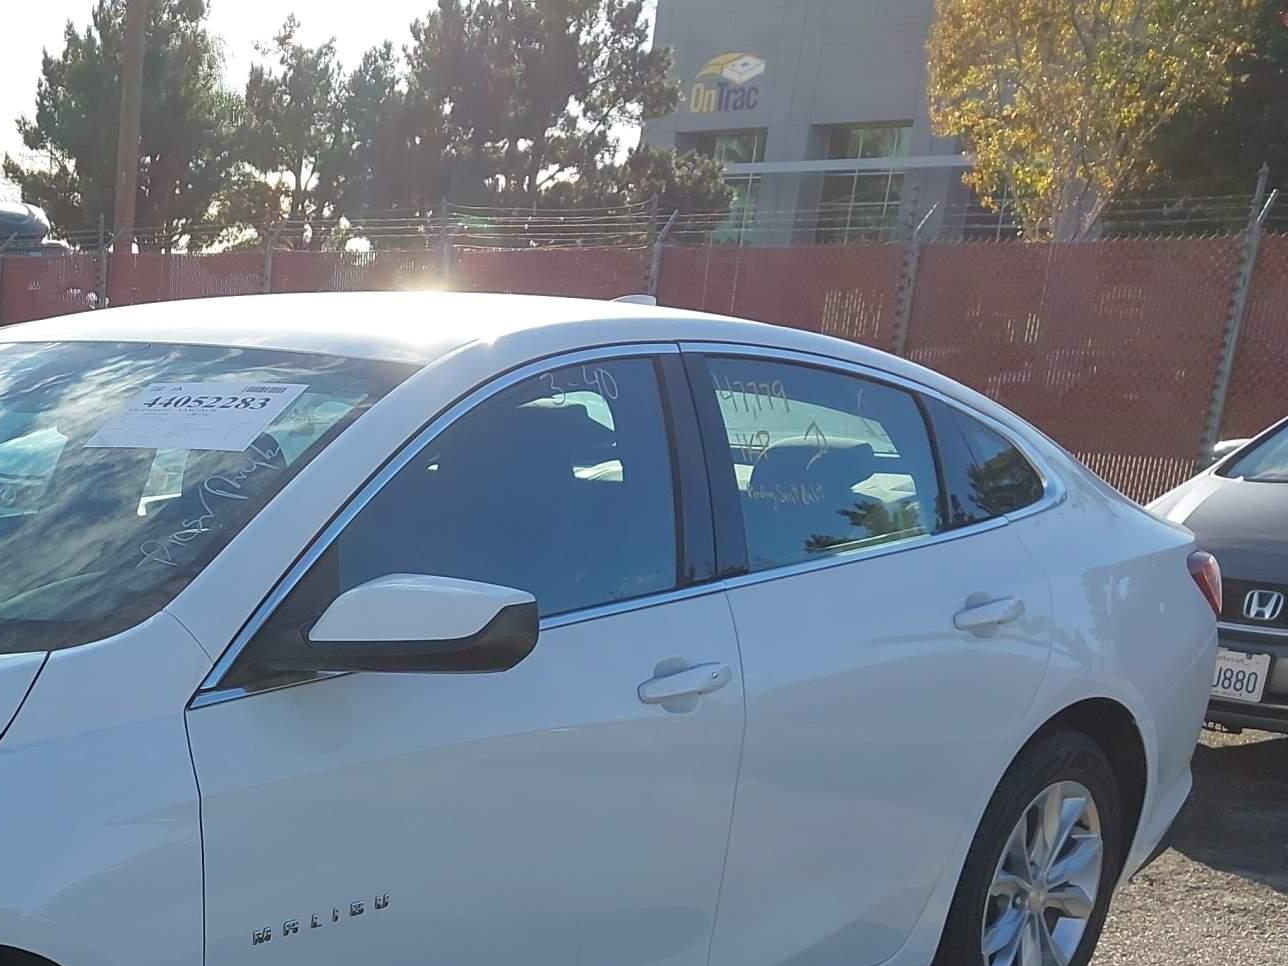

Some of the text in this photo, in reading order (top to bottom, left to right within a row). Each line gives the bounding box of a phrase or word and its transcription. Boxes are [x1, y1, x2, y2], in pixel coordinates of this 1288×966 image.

[690, 82, 759, 113] OnTrac
[143, 395, 273, 410] 44052283
[252, 893, 390, 946] MALIBU
